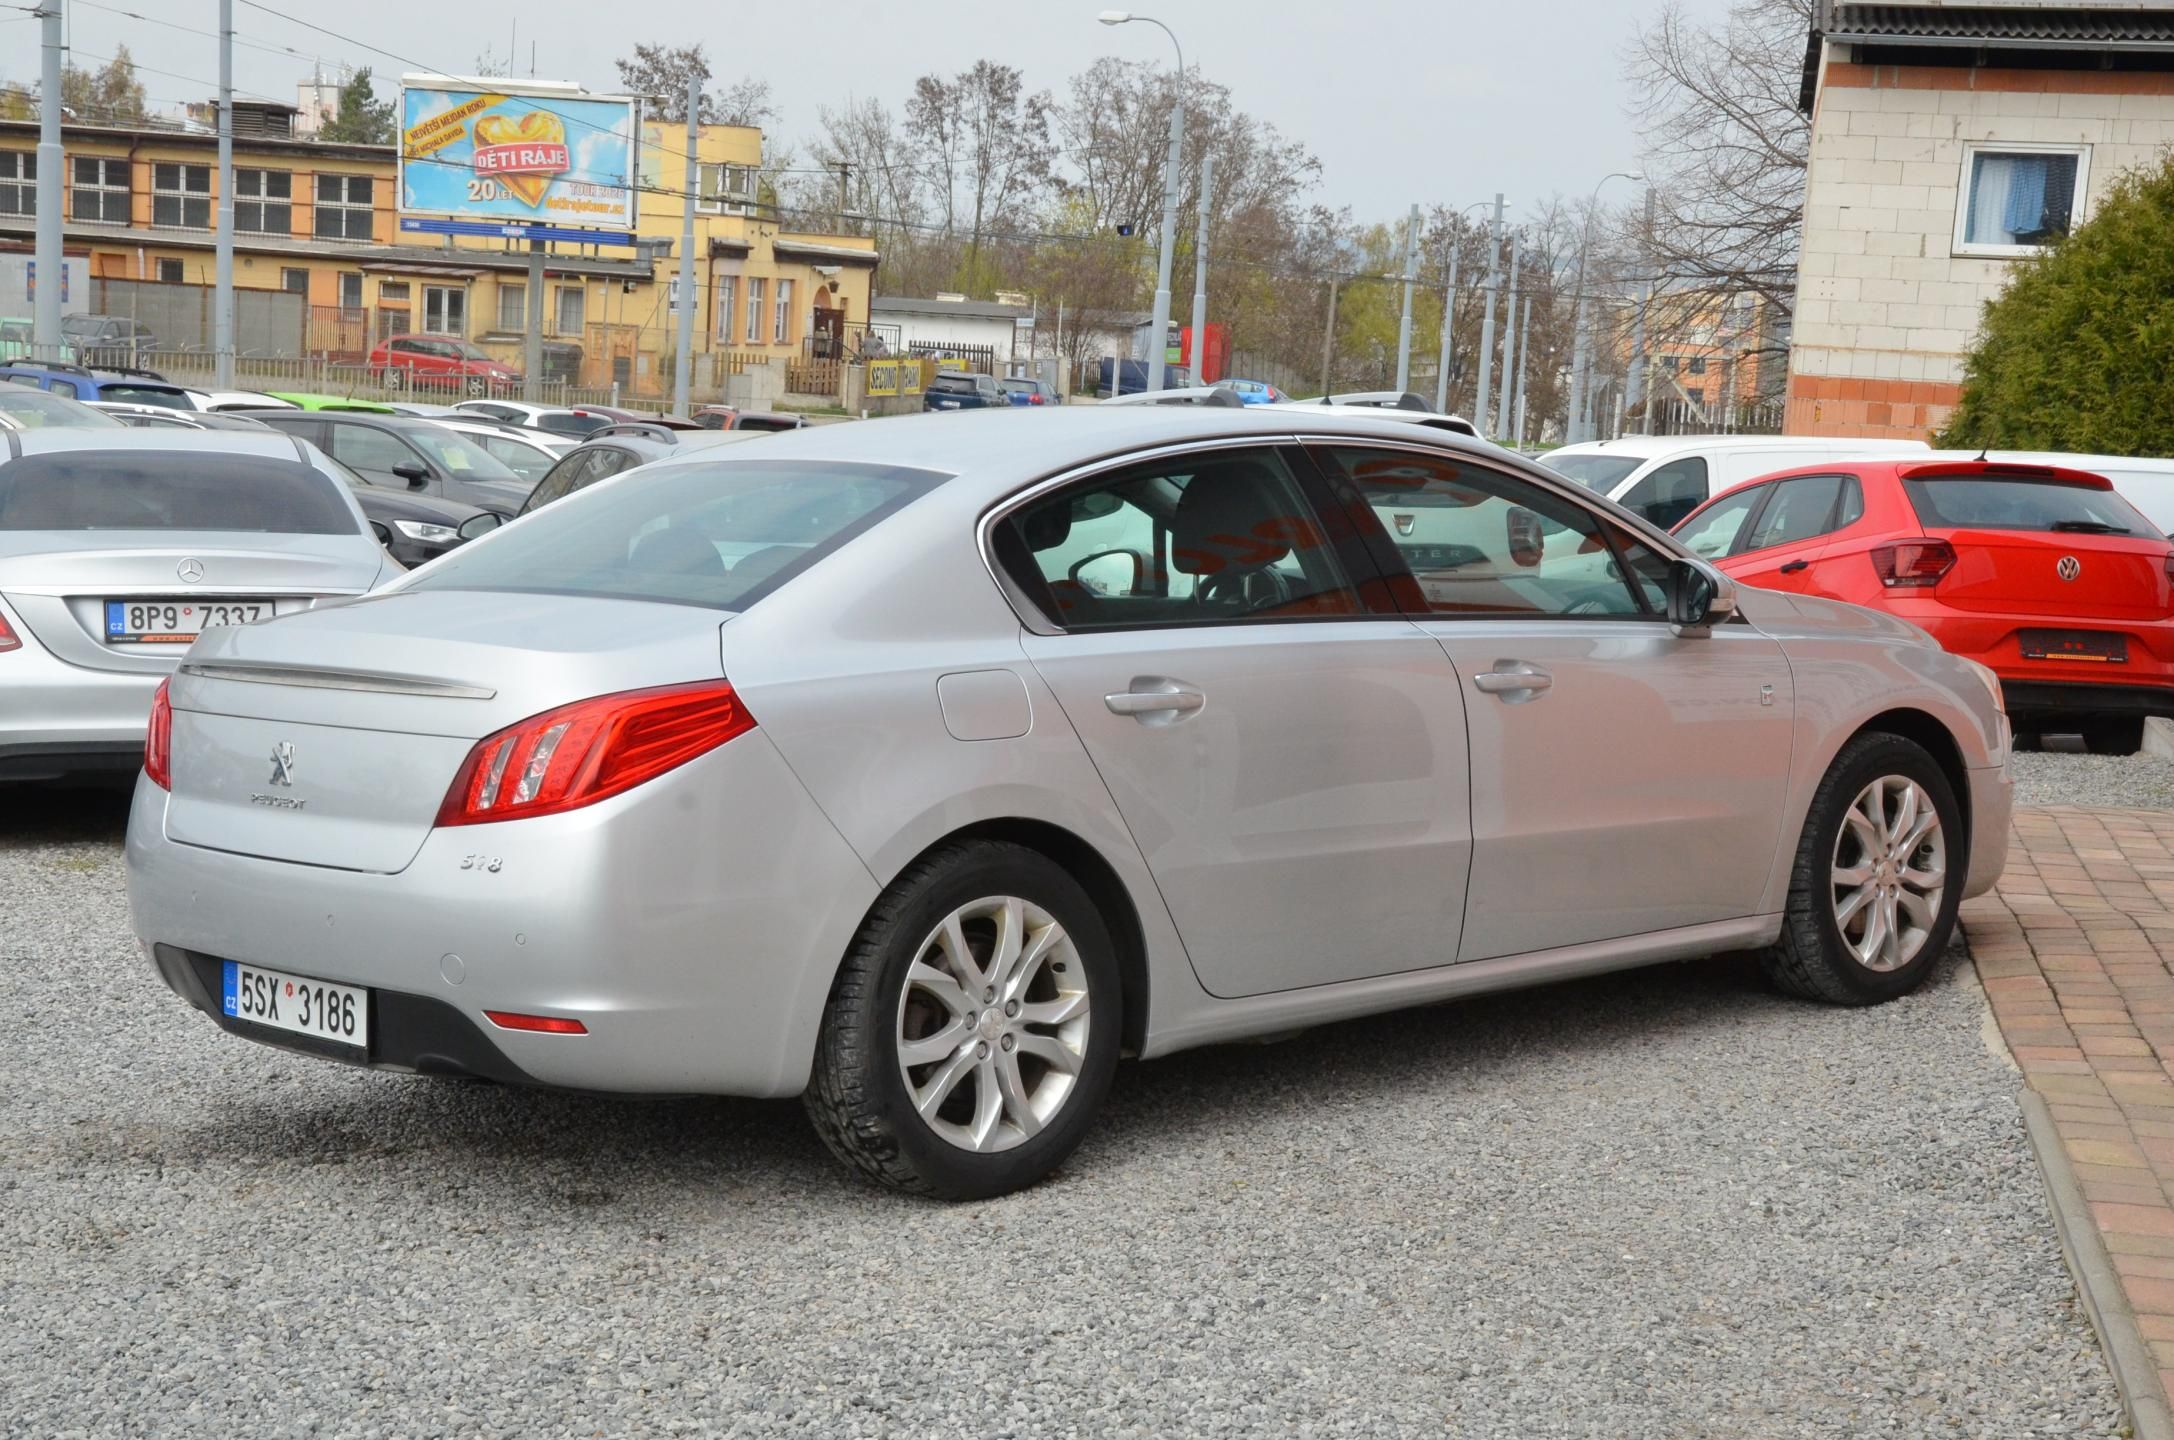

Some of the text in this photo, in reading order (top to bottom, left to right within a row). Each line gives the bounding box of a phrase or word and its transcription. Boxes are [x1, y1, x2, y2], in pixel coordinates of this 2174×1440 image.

[410, 98, 486, 141] NEJVĚTŠÍ MEJDAN ROKU
[477, 146, 565, 169] DĚTI RÁJE
[467, 179, 513, 202] 20 LET
[570, 183, 597, 197] TOUR
[871, 366, 897, 390] SECOND
[1400, 549, 1462, 558] TER
[110, 622, 123, 631] CZ
[131, 606, 260, 630] 8P9 7337
[250, 792, 306, 810] PEUGEOT
[225, 995, 236, 1010] CZ
[242, 970, 355, 1036] 5SX 3186
